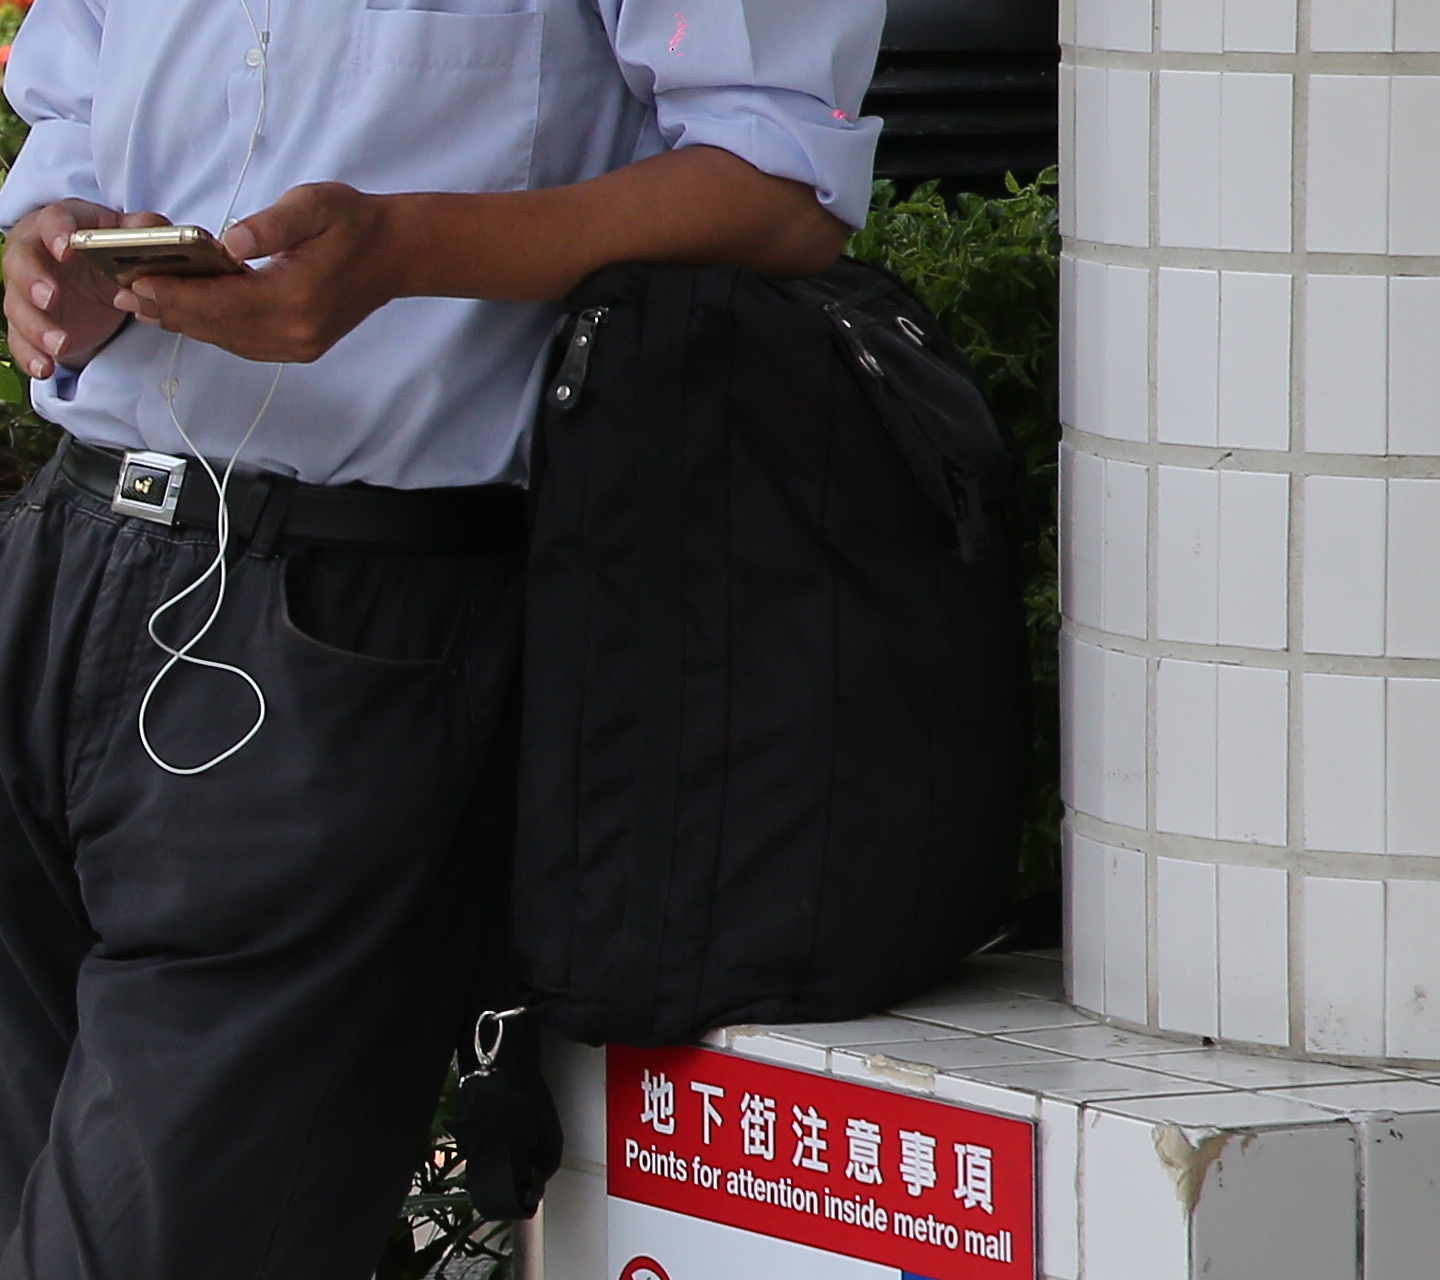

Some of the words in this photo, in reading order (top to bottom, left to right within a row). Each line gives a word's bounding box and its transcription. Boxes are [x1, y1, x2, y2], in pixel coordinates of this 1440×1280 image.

[626, 1139, 687, 1181] Points
[692, 1156, 721, 1189] for
[727, 1169, 818, 1214] attention
[825, 1188, 887, 1231] inside
[894, 1213, 958, 1248] metro
[965, 1230, 1010, 1262] mall
[641, 1070, 992, 1214] 地下街注意事項
